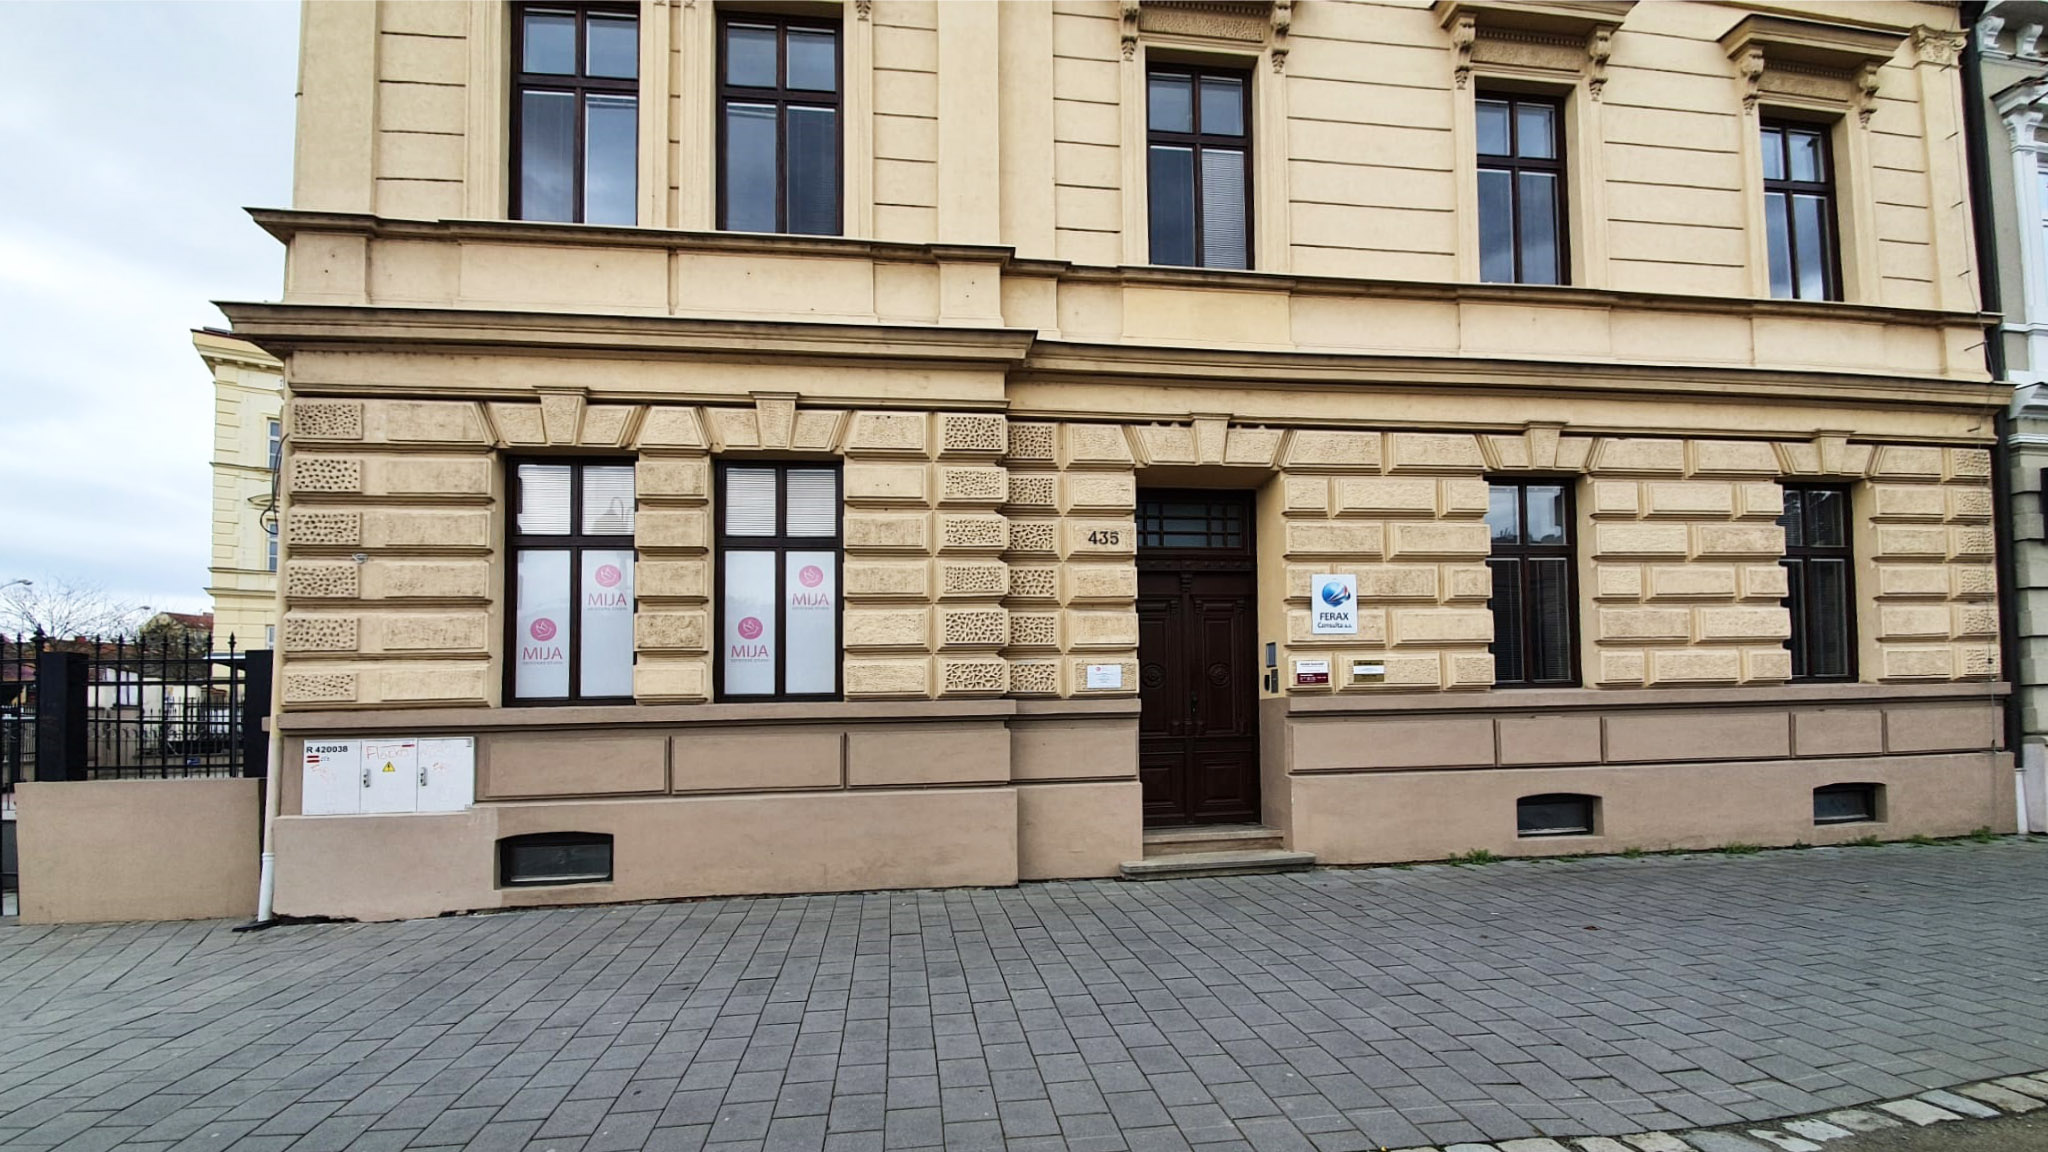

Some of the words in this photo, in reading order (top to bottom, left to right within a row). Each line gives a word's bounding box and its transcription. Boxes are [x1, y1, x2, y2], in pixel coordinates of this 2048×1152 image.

[1088, 530, 1119, 545] 435
[588, 592, 627, 606] MIJA
[792, 592, 830, 606] MIJA
[1319, 612, 1349, 621] FERAX
[522, 646, 563, 660] MIJA
[730, 644, 769, 658] MIJA
[315, 745, 348, 753] 420038
